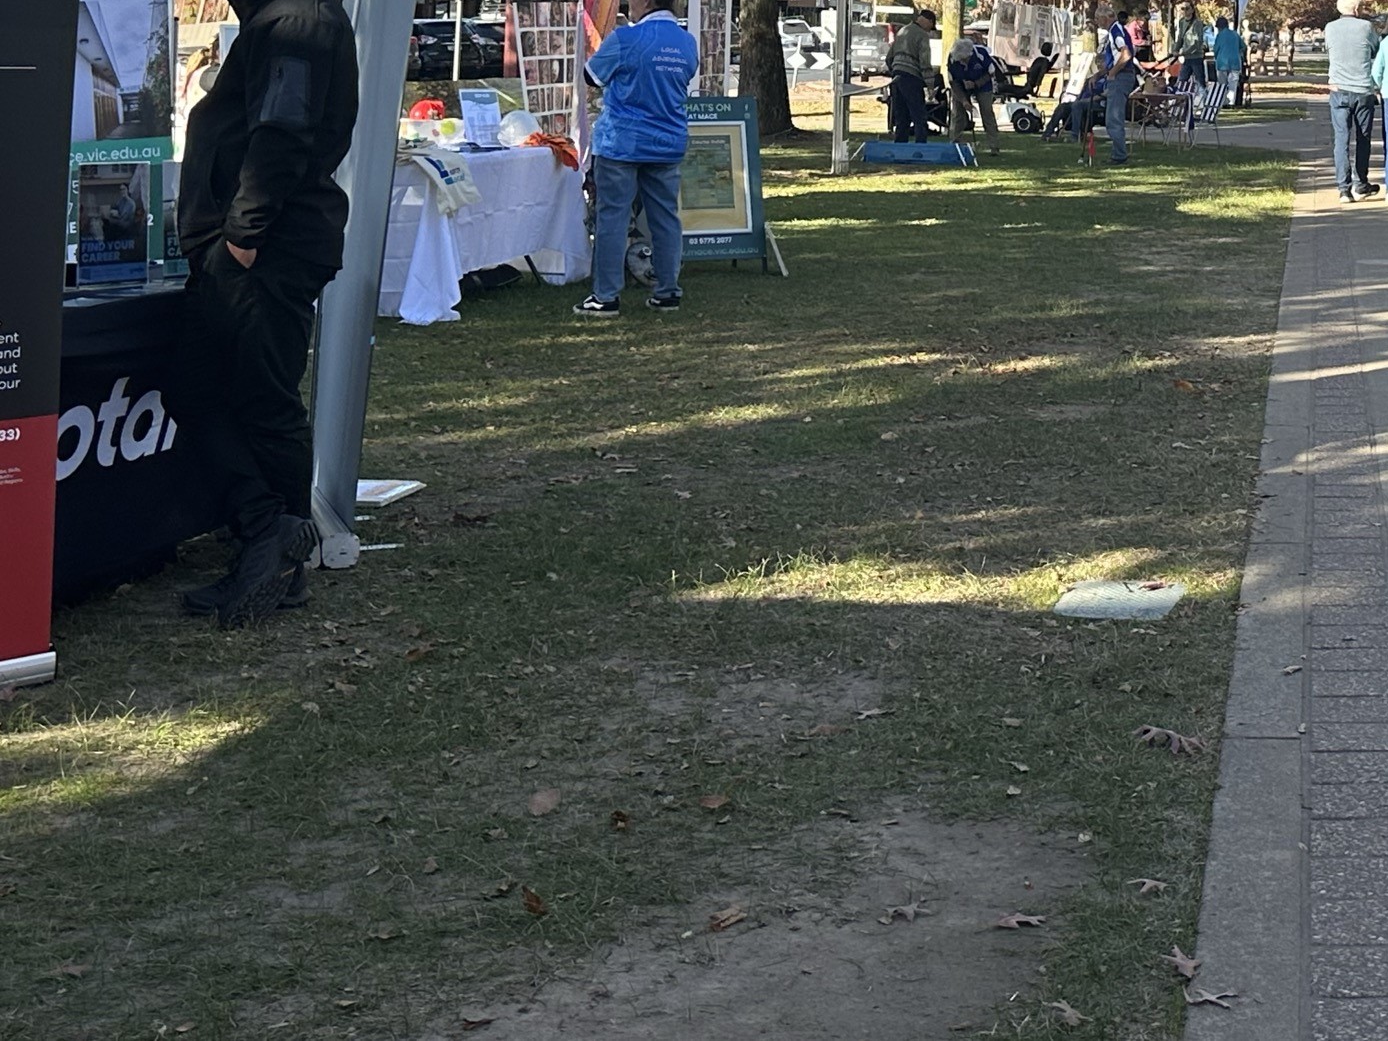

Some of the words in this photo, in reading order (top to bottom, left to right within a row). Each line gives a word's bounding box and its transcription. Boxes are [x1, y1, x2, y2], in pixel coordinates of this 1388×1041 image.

[683, 103, 714, 112] HAT'S
[716, 103, 731, 112] ON
[81, 241, 105, 253] FIND
[107, 239, 135, 250] YOUR
